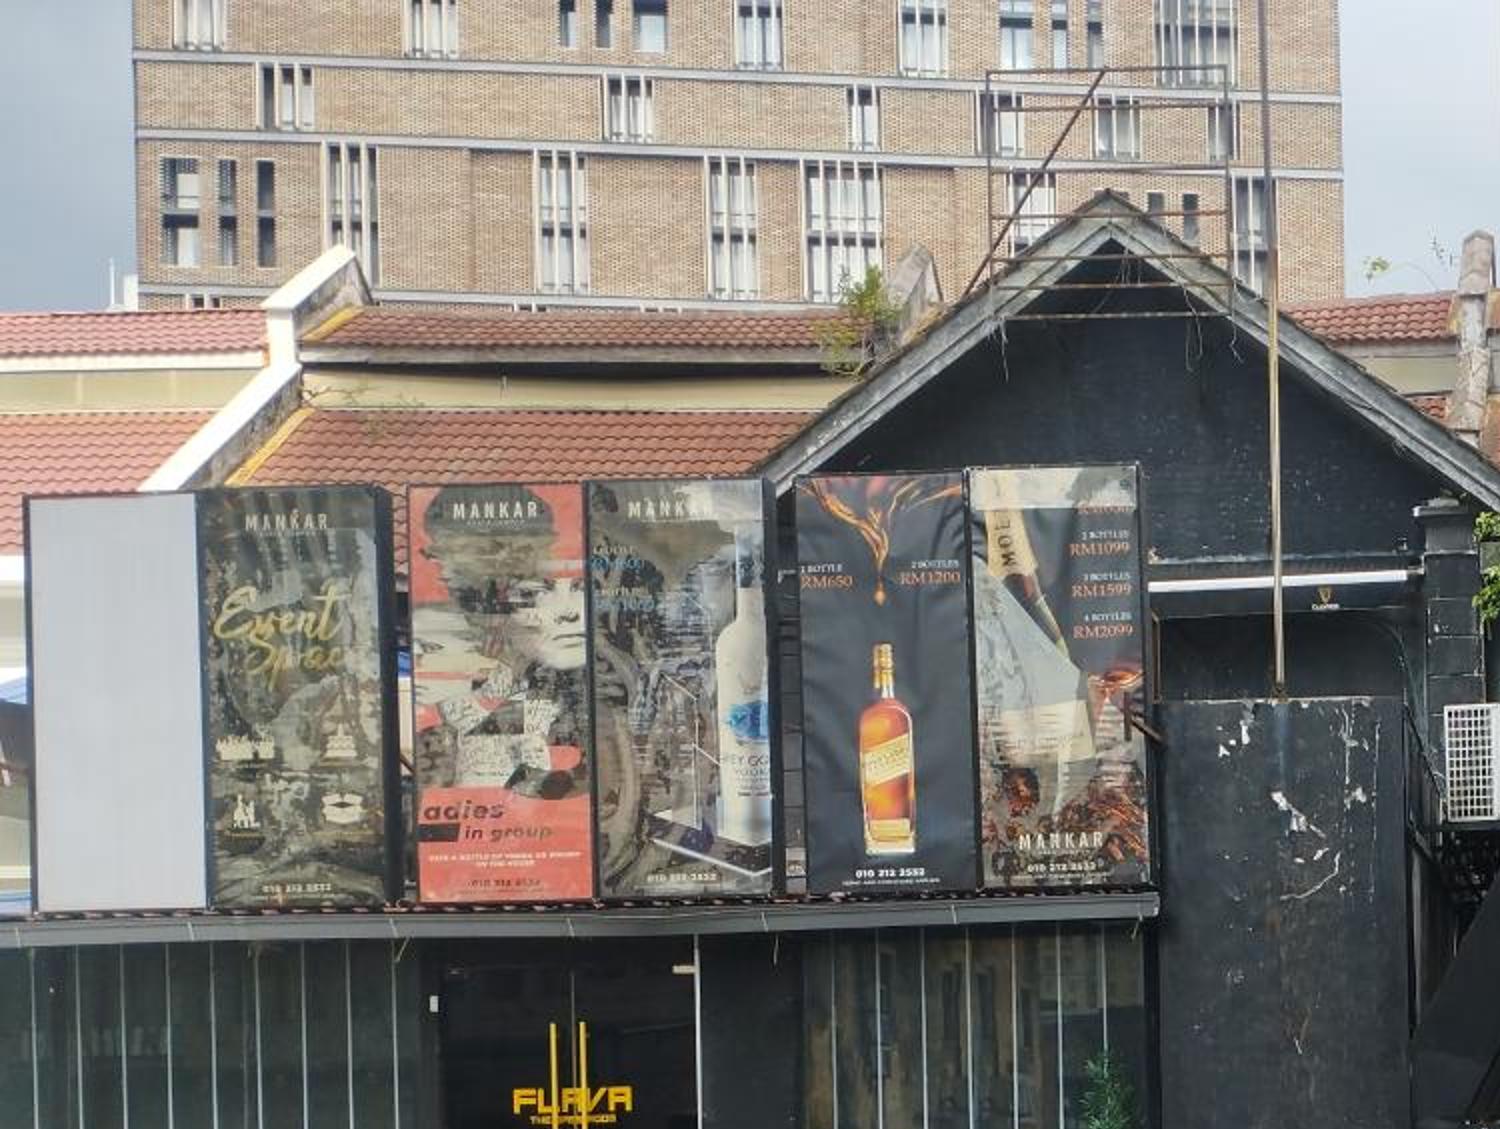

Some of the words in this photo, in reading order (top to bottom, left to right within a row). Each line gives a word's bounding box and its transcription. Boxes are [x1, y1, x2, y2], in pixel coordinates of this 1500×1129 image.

[453, 501, 537, 519] MANKAR
[245, 513, 328, 531] MANKAR
[807, 563, 842, 573] BOTTLE
[917, 560, 959, 569] BOTTLES
[801, 575, 853, 588] RM650
[900, 570, 960, 585] RM1200
[214, 578, 352, 641] Event
[1073, 624, 1133, 639] RM2099
[465, 826, 483, 840] in
[490, 826, 553, 842] group
[1019, 831, 1103, 850] MANKAR
[855, 869, 875, 879] 010
[878, 869, 896, 878] 212
[512, 1086, 633, 1114] FLAVA
